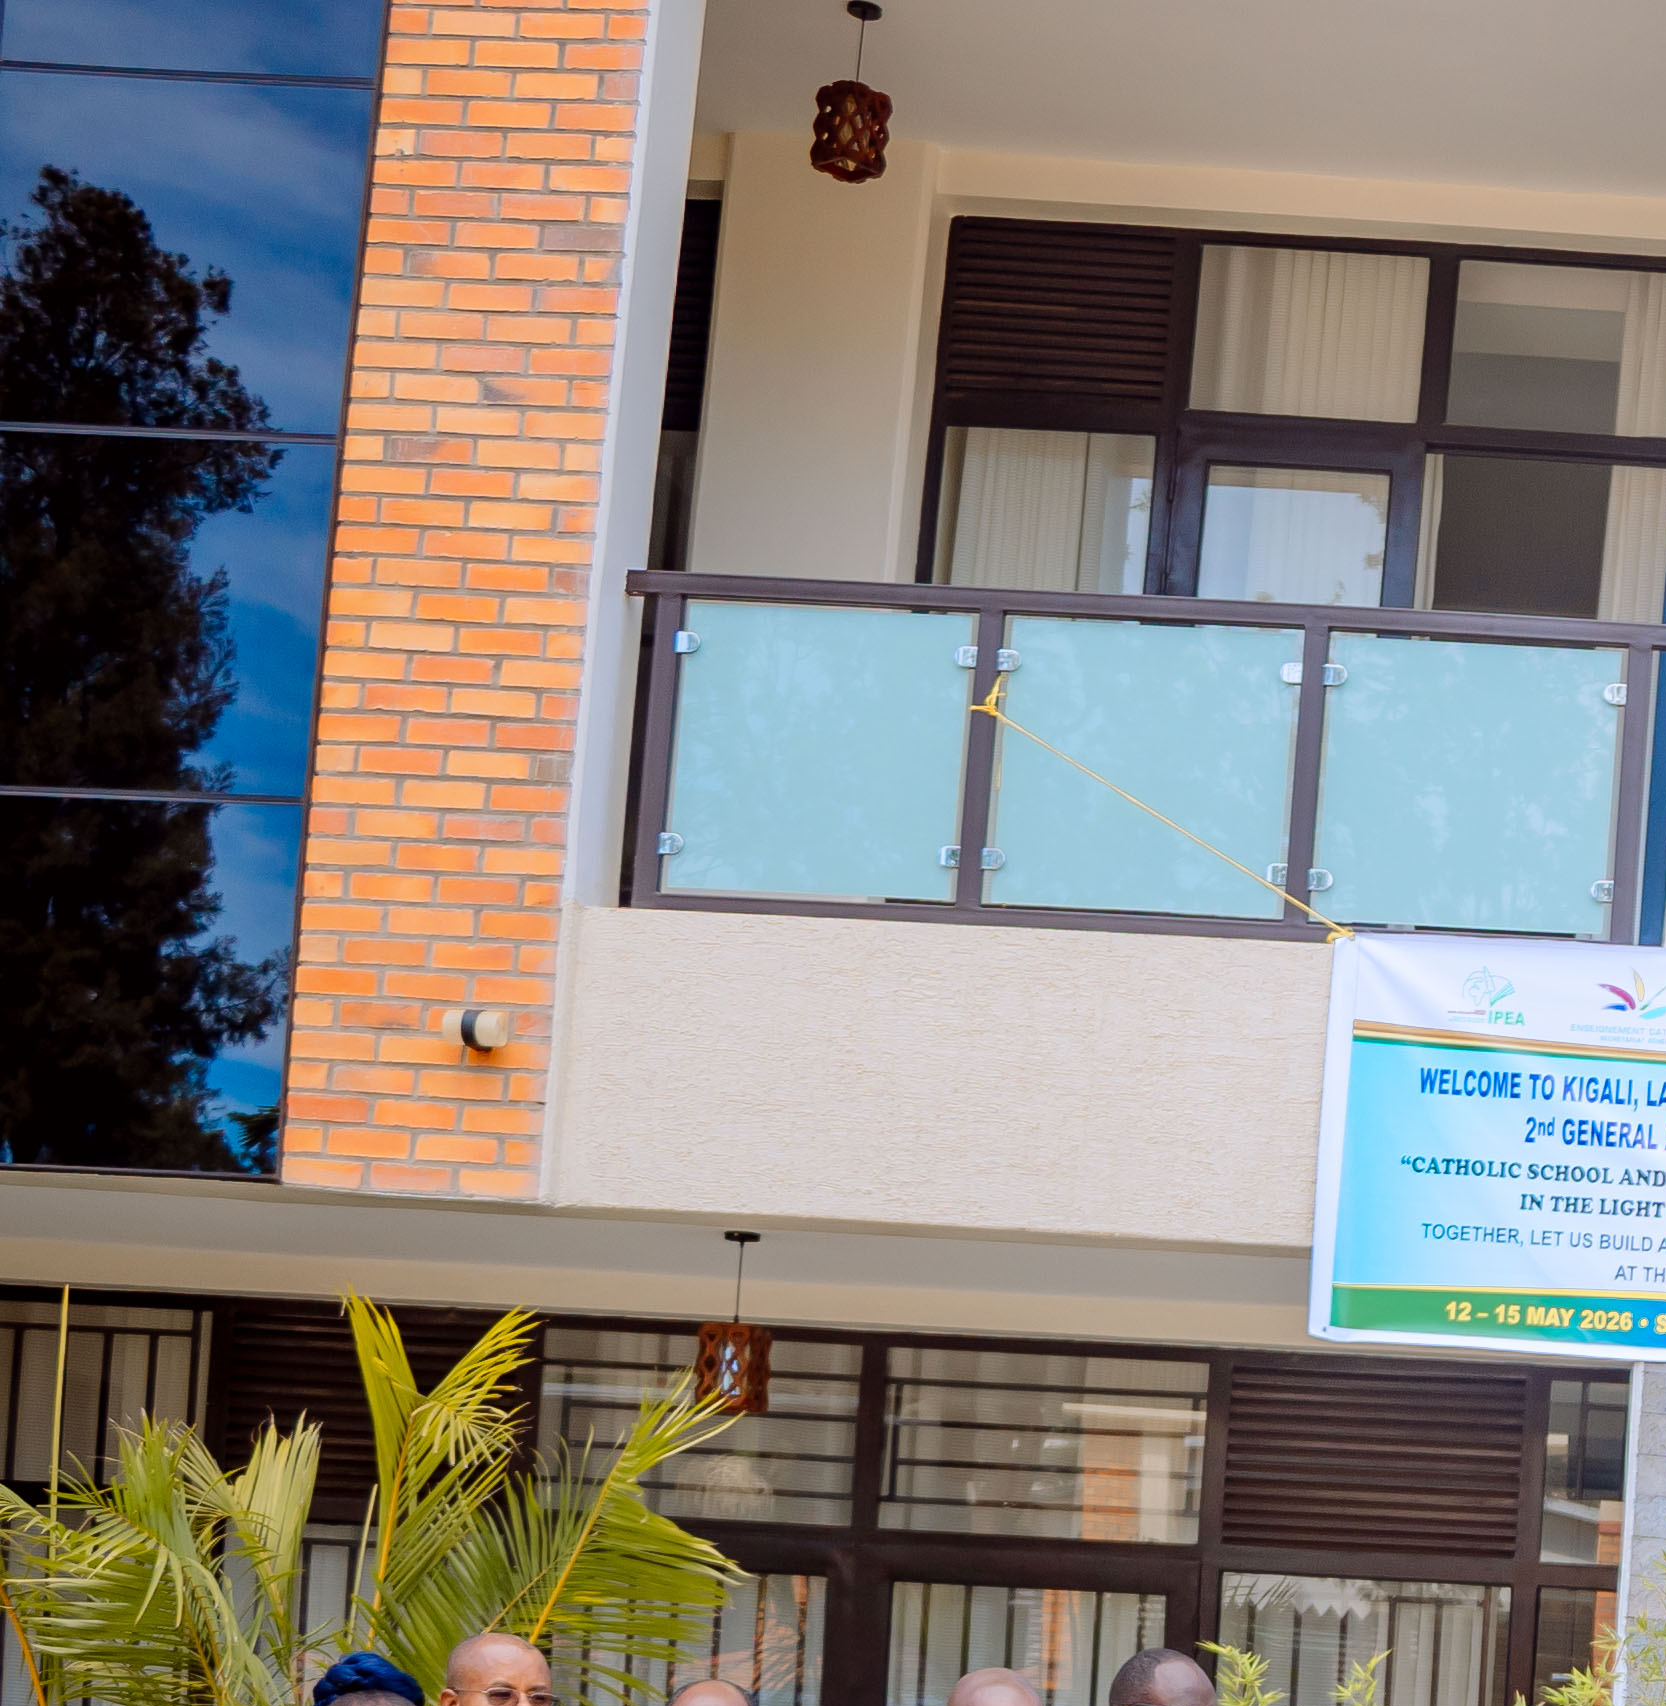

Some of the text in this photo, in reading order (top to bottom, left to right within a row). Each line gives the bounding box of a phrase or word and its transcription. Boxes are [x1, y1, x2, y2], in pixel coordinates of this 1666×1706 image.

[1488, 1011, 1525, 1026] IPEA
[1420, 1067, 1523, 1100] WELCOME
[1528, 1073, 1556, 1102] TO
[1562, 1075, 1639, 1113] KIGALI,
[1524, 1116, 1556, 1144] 2nd
[1561, 1118, 1659, 1151] GENERAL
[1527, 1163, 1615, 1185] SCHOOL
[1520, 1193, 1546, 1212] IN
[1549, 1195, 1594, 1215] THE
[1598, 1197, 1666, 1219] LIGHT
[1421, 1222, 1524, 1248] TOGETHER,
[1530, 1229, 1565, 1248] LET
[1569, 1231, 1594, 1250] US
[1599, 1233, 1654, 1253] BUILD
[1614, 1265, 1638, 1282] AT
[1445, 1301, 1473, 1322] 12
[1494, 1304, 1521, 1326] 15
[1525, 1306, 1574, 1329] MAY
[1578, 1308, 1634, 1334] 2026
